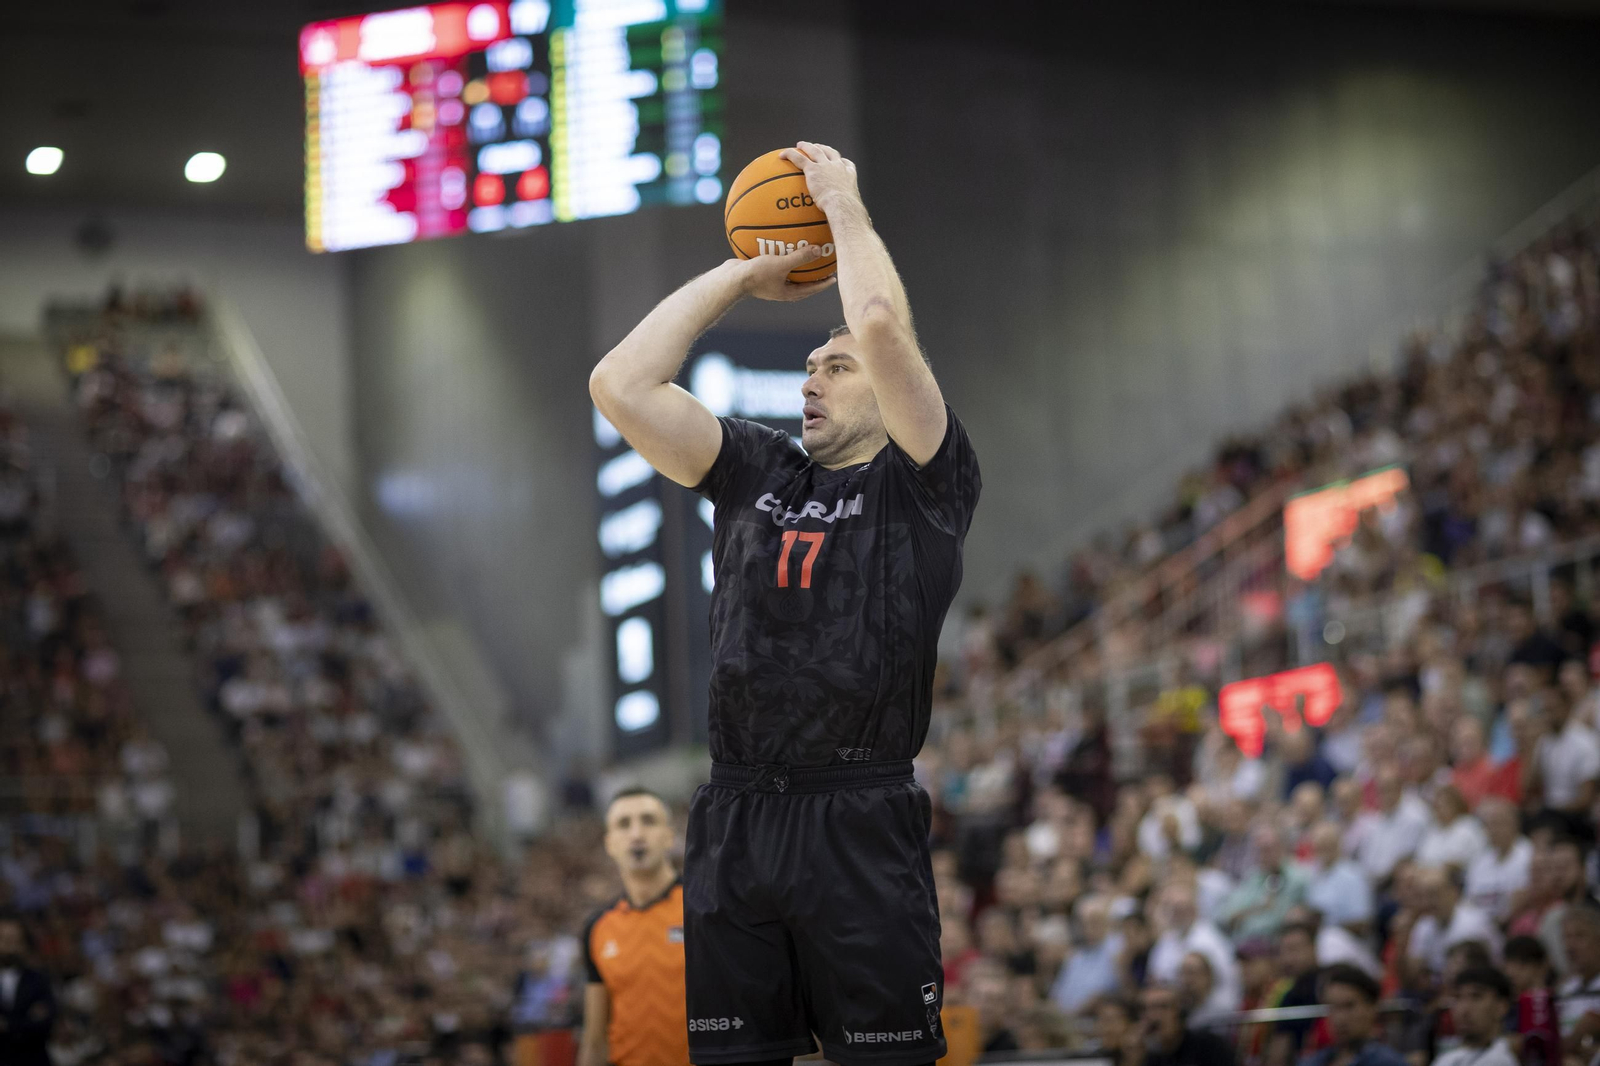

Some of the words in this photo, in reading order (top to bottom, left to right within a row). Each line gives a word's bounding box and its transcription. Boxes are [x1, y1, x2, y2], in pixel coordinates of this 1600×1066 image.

[776, 193, 814, 210] acb
[777, 530, 825, 588] 17
[689, 1017, 730, 1032] asisa
[853, 1029, 923, 1043] BERNER
